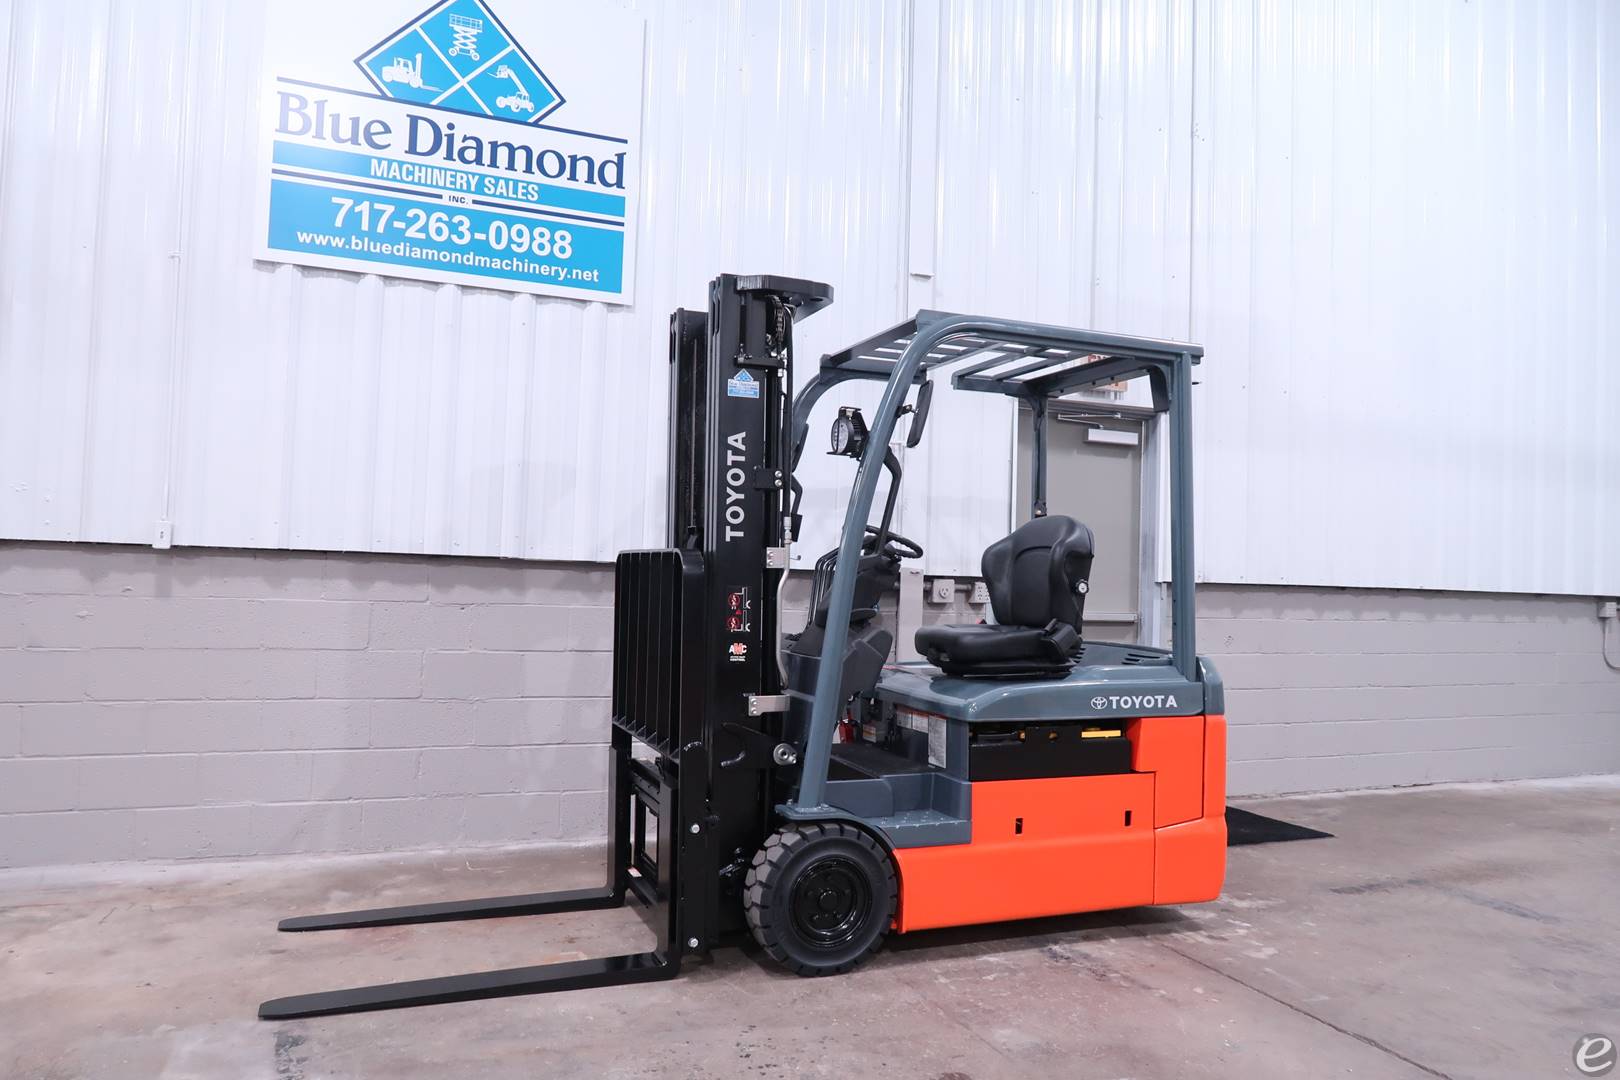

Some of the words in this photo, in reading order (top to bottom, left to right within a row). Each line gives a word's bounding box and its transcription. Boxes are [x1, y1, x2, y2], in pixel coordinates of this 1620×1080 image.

[275, 91, 392, 150] Blue
[404, 113, 627, 190] Diamond
[369, 158, 479, 193] MACHINERY
[484, 177, 540, 202] SALES
[448, 195, 469, 205] INC.
[331, 196, 574, 260] 717-263-0988
[296, 230, 600, 283] www.bluediamondmachinery.net
[725, 431, 747, 542] TOYOTA
[1108, 694, 1178, 710] TOYOTA
